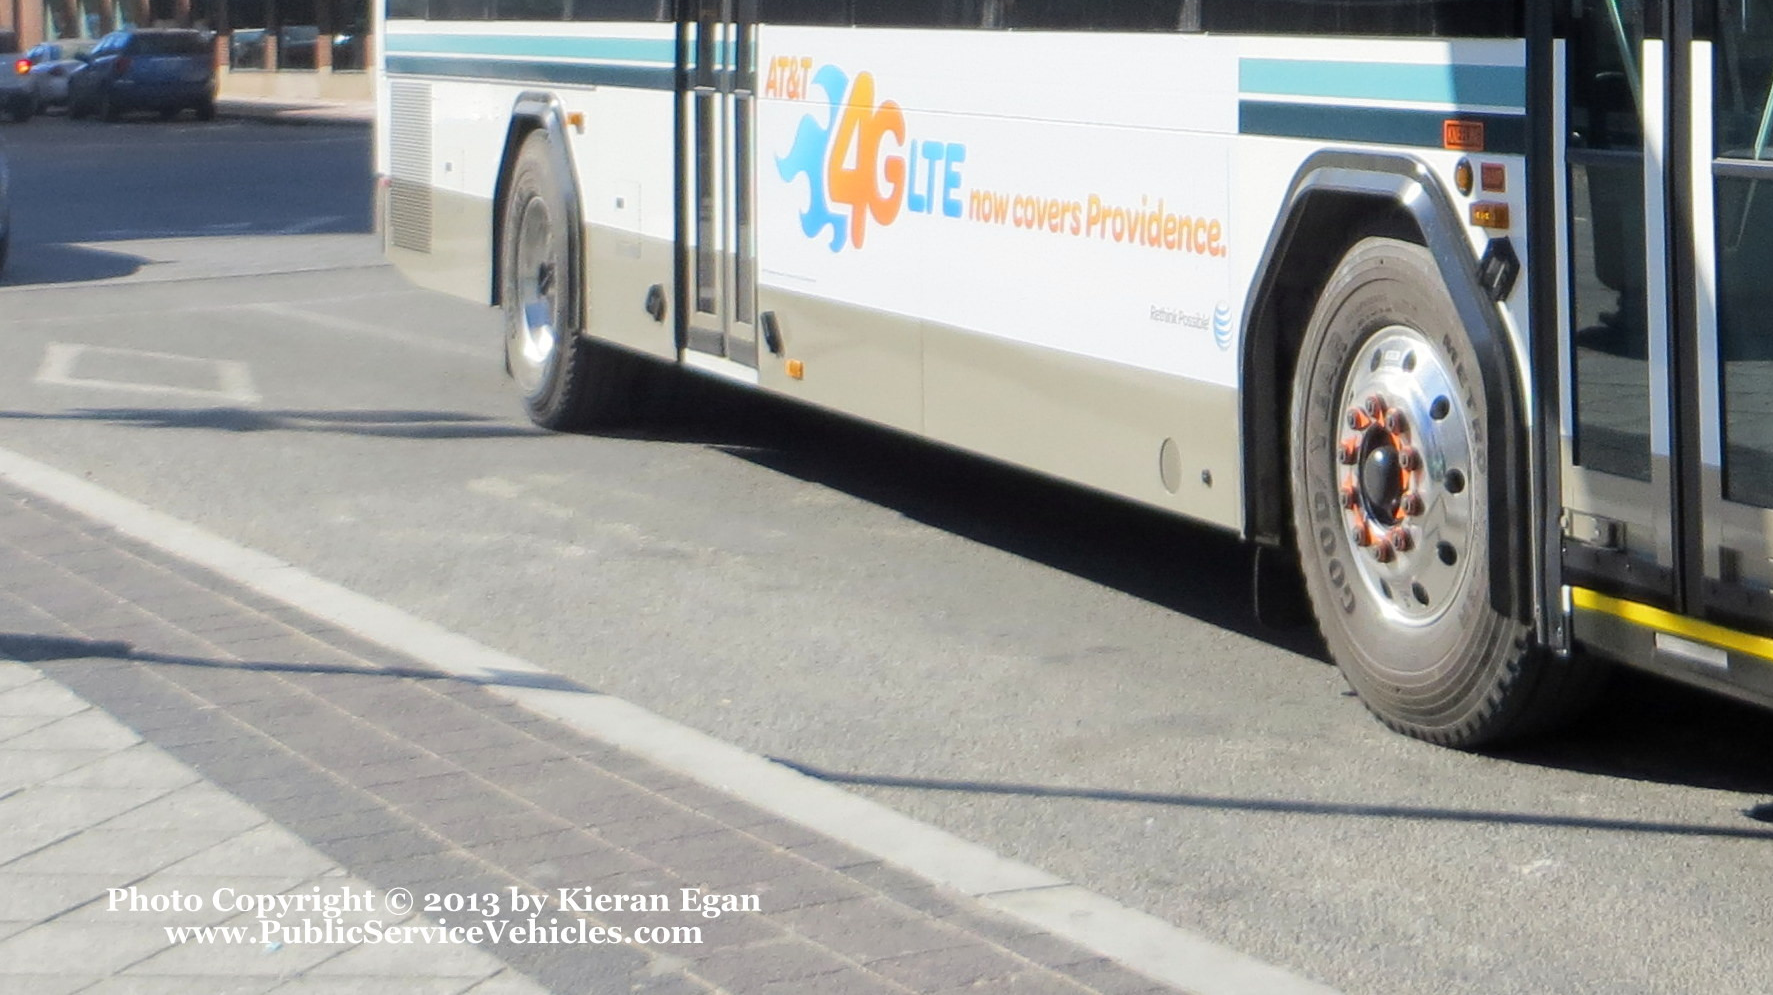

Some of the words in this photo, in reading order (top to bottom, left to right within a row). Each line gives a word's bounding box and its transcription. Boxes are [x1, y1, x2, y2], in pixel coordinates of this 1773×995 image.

[765, 56, 813, 100] AT&T
[827, 71, 906, 250] 4G
[907, 138, 967, 219] LTE
[968, 187, 1009, 226] now
[1012, 193, 1082, 237] covers
[1086, 192, 1227, 259] Providence.
[1150, 304, 1177, 325] Rethink
